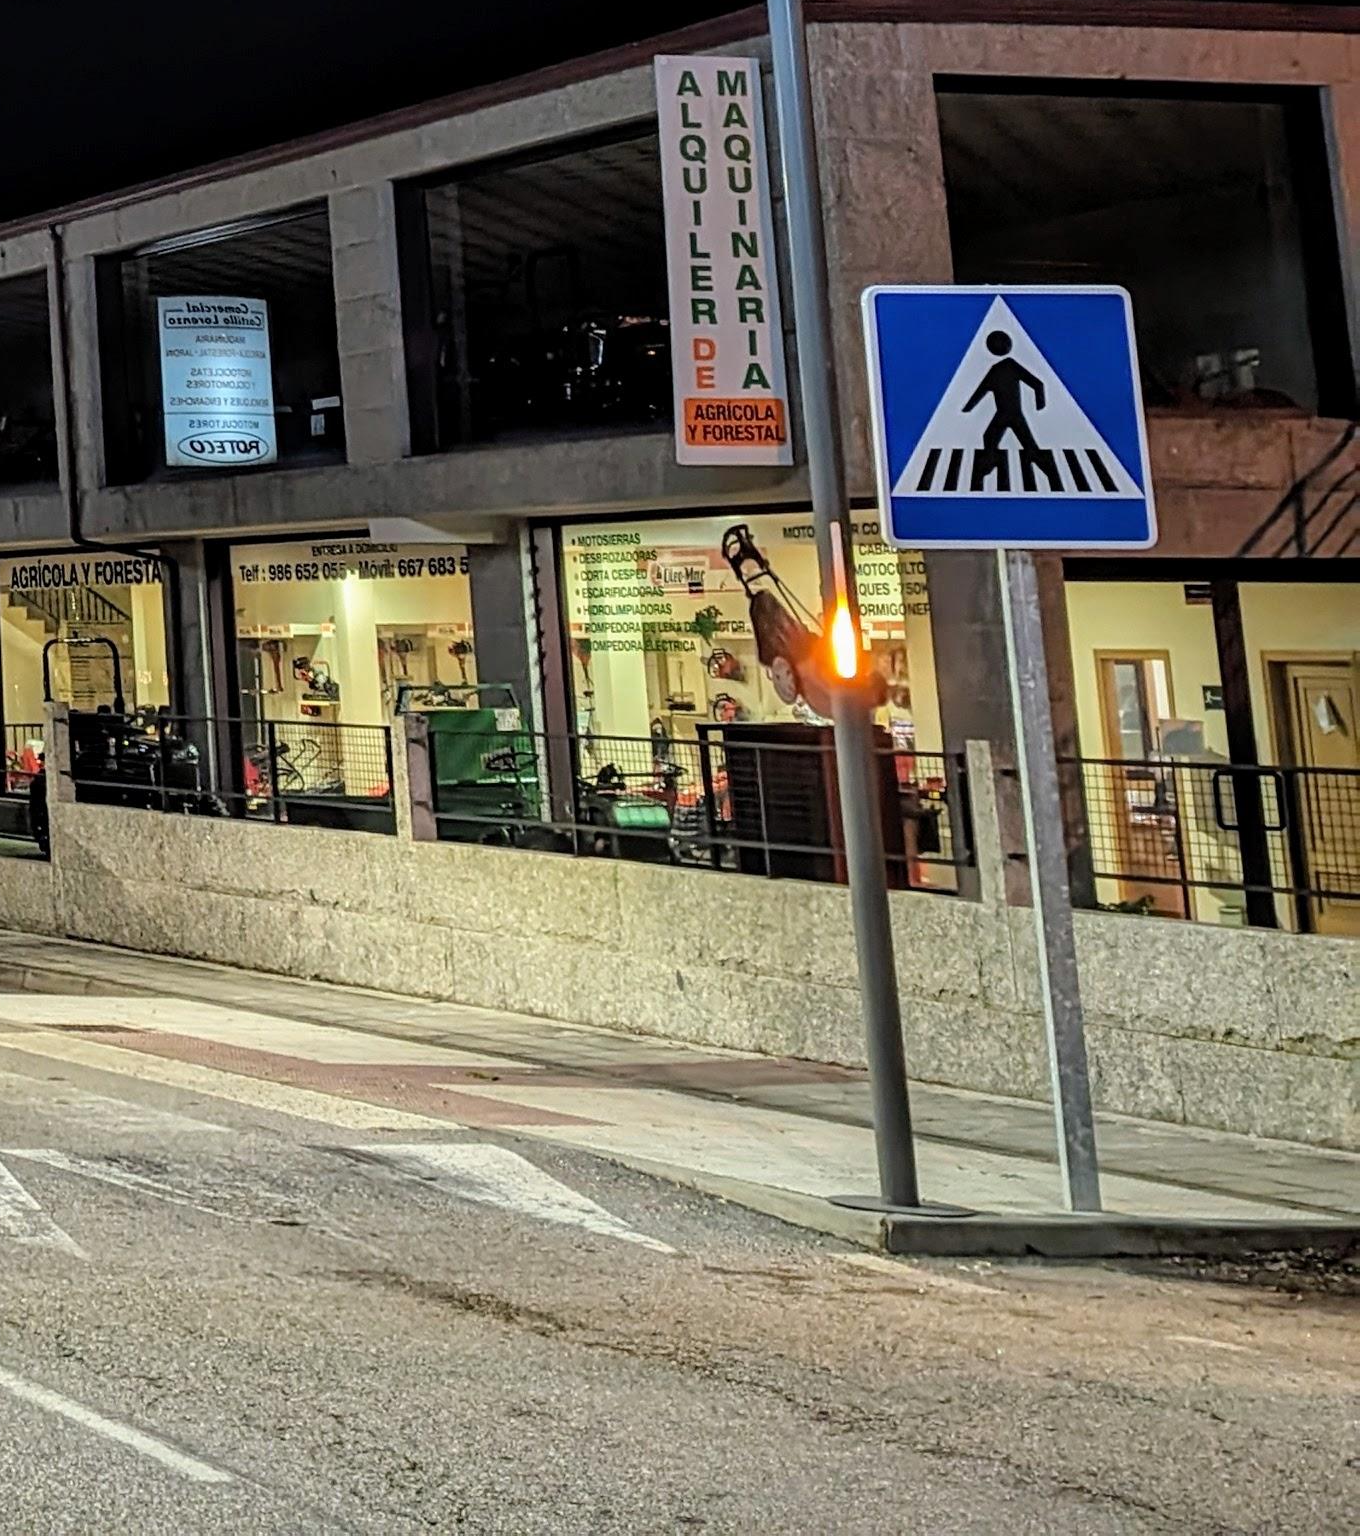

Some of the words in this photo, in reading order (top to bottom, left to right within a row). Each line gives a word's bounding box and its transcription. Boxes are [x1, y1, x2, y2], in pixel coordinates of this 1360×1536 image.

[676, 70, 718, 325] ALQUILER
[717, 70, 771, 390] MAQUINARIA
[692, 338, 717, 390] DE
[694, 402, 776, 421] AGRÍCOLA
[688, 425, 697, 440] Y
[702, 424, 786, 442] FORESTAL
[862, 523, 879, 535] CO
[578, 533, 641, 546] MOTOSIERRAS
[580, 550, 657, 563] DESBROZADORAS
[11, 559, 78, 589] AGRÍCOLA
[81, 563, 90, 585] Y
[95, 560, 162, 584] FORESTA
[269, 564, 292, 581] 986
[295, 563, 318, 580] 652
[398, 558, 424, 577] 667
[428, 557, 456, 576] 683
[460, 556, 469, 575] 5
[856, 562, 926, 576] MOTOCULTO
[589, 640, 643, 652] OMPEDORA
